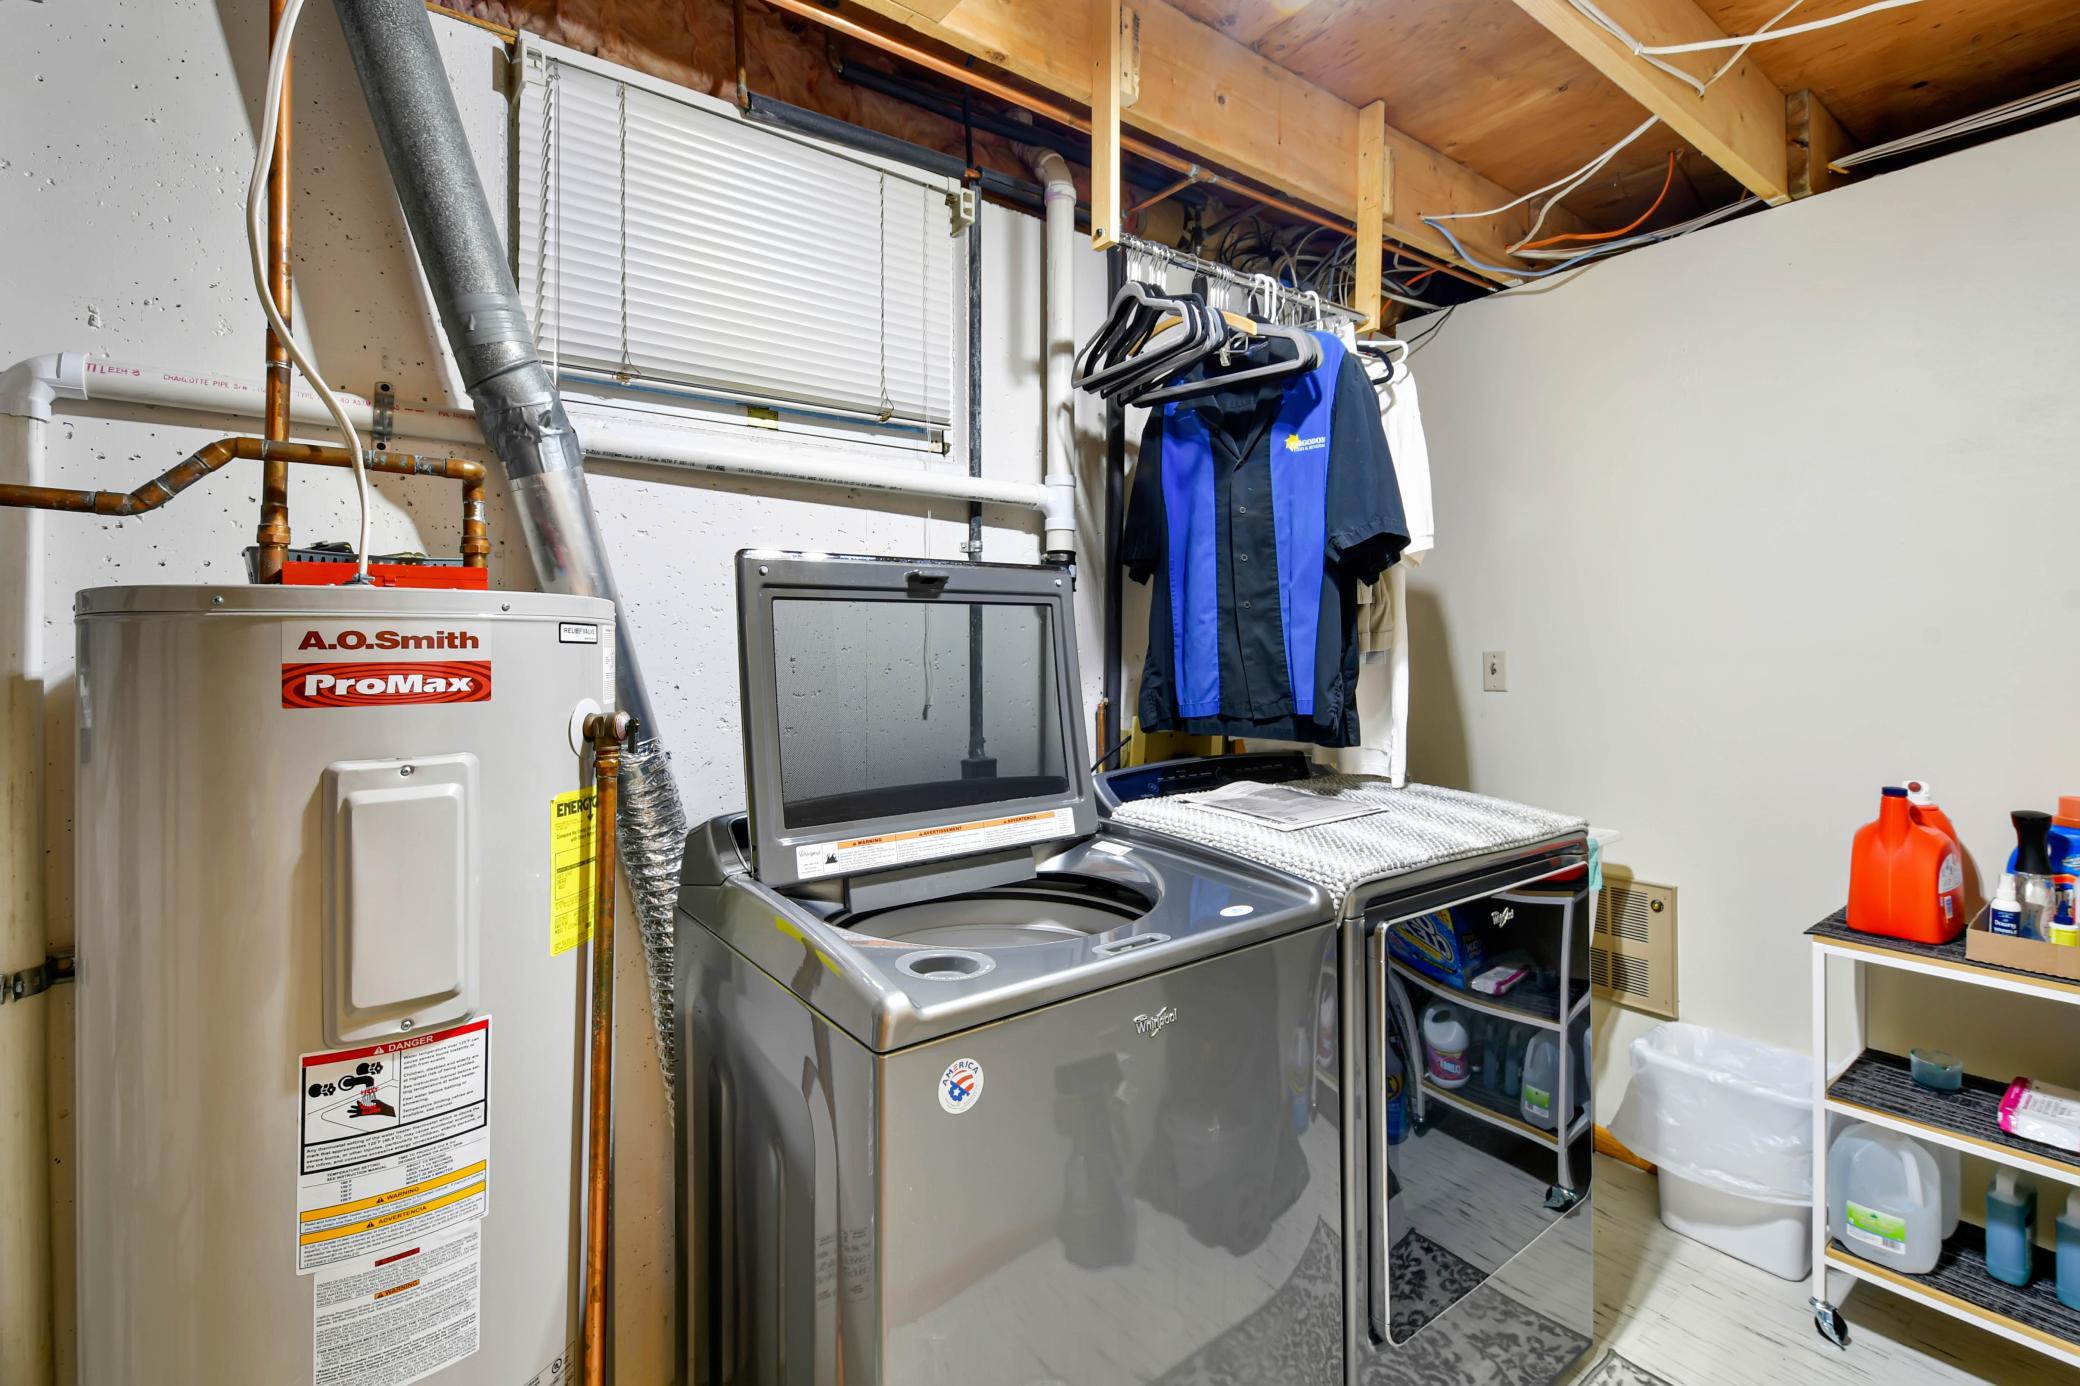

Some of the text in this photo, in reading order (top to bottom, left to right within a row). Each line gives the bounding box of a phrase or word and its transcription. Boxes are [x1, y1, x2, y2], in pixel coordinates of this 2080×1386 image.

[305, 674, 472, 696] ProMax
[1133, 1006, 1177, 1037] Whirlpool
[388, 1036, 433, 1052] DANGER
[942, 1061, 978, 1086] AMERICA
[386, 1186, 419, 1200] WARNING
[378, 1205, 426, 1224] ADVERTENCIA
